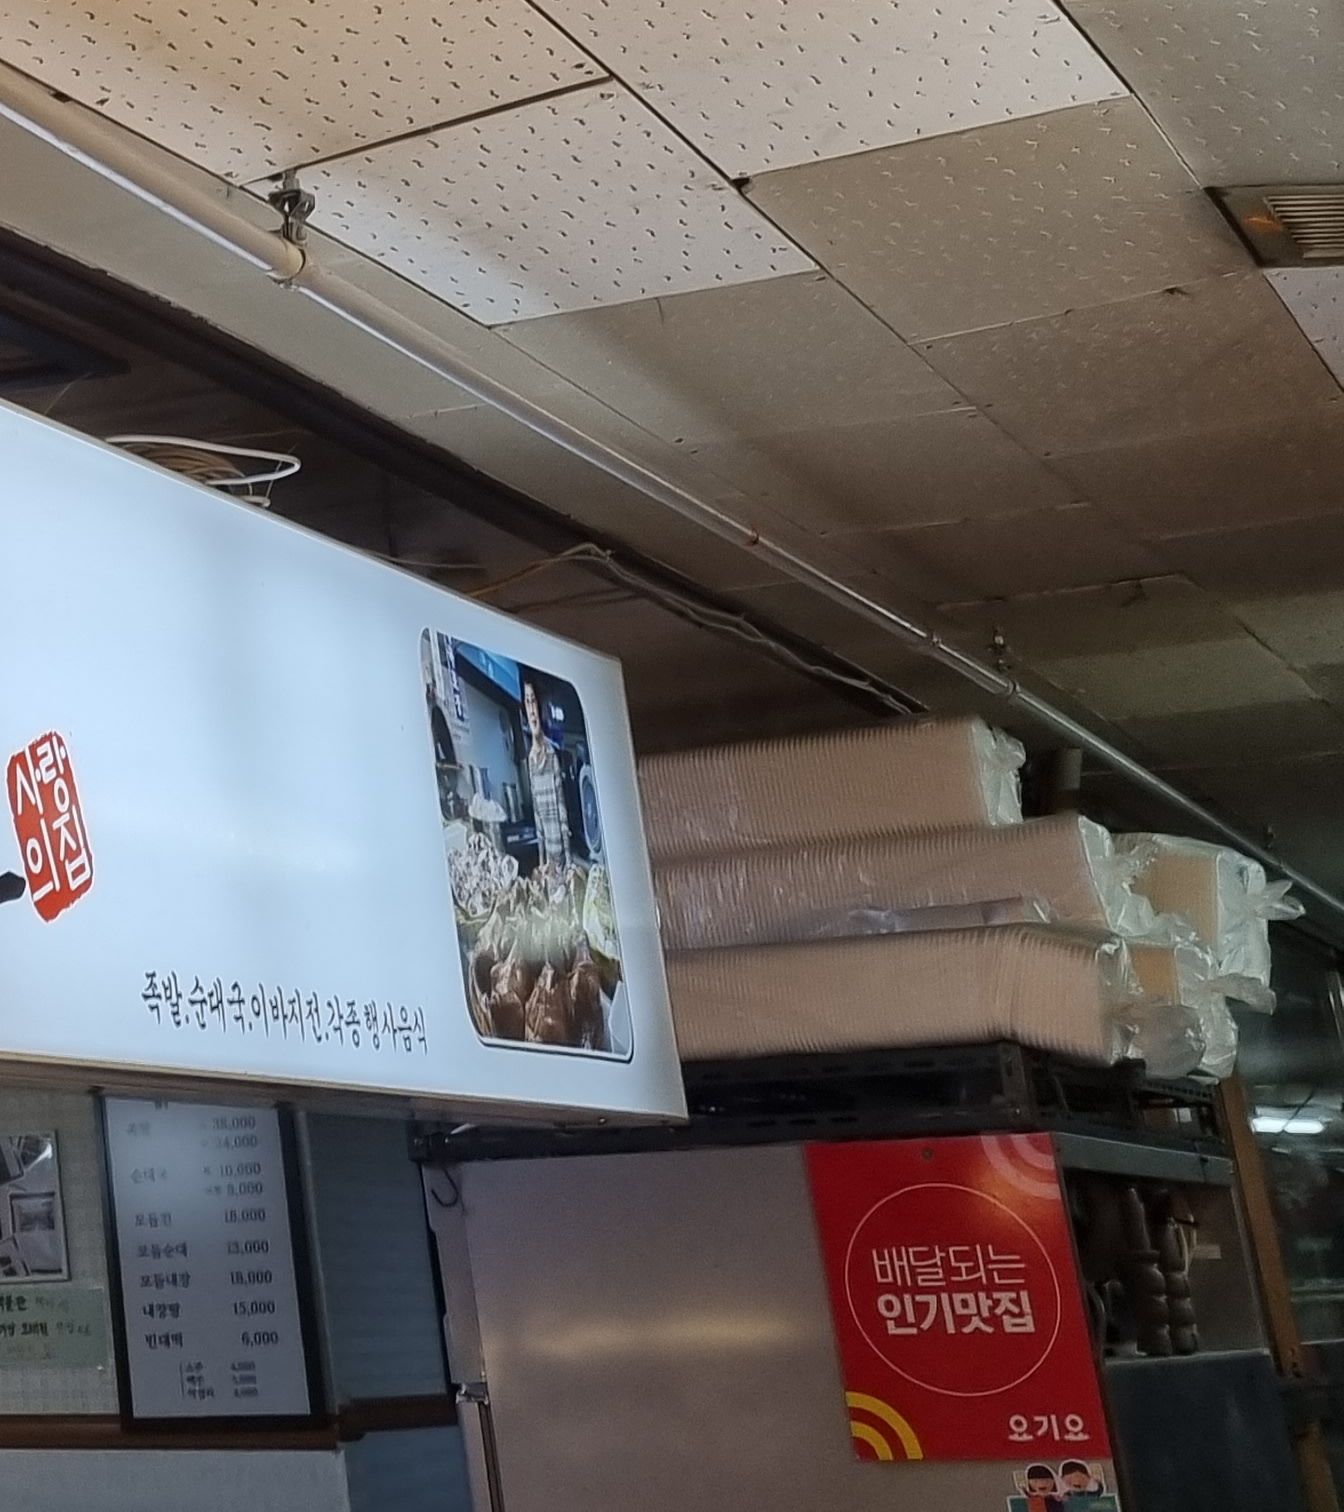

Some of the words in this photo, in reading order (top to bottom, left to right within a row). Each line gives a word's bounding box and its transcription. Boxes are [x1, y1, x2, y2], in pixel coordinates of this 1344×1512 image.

[871, 1243, 1026, 1288] 배달되는
[877, 1289, 1036, 1336] 인기맛집
[1008, 1413, 1091, 1442] 요기요
